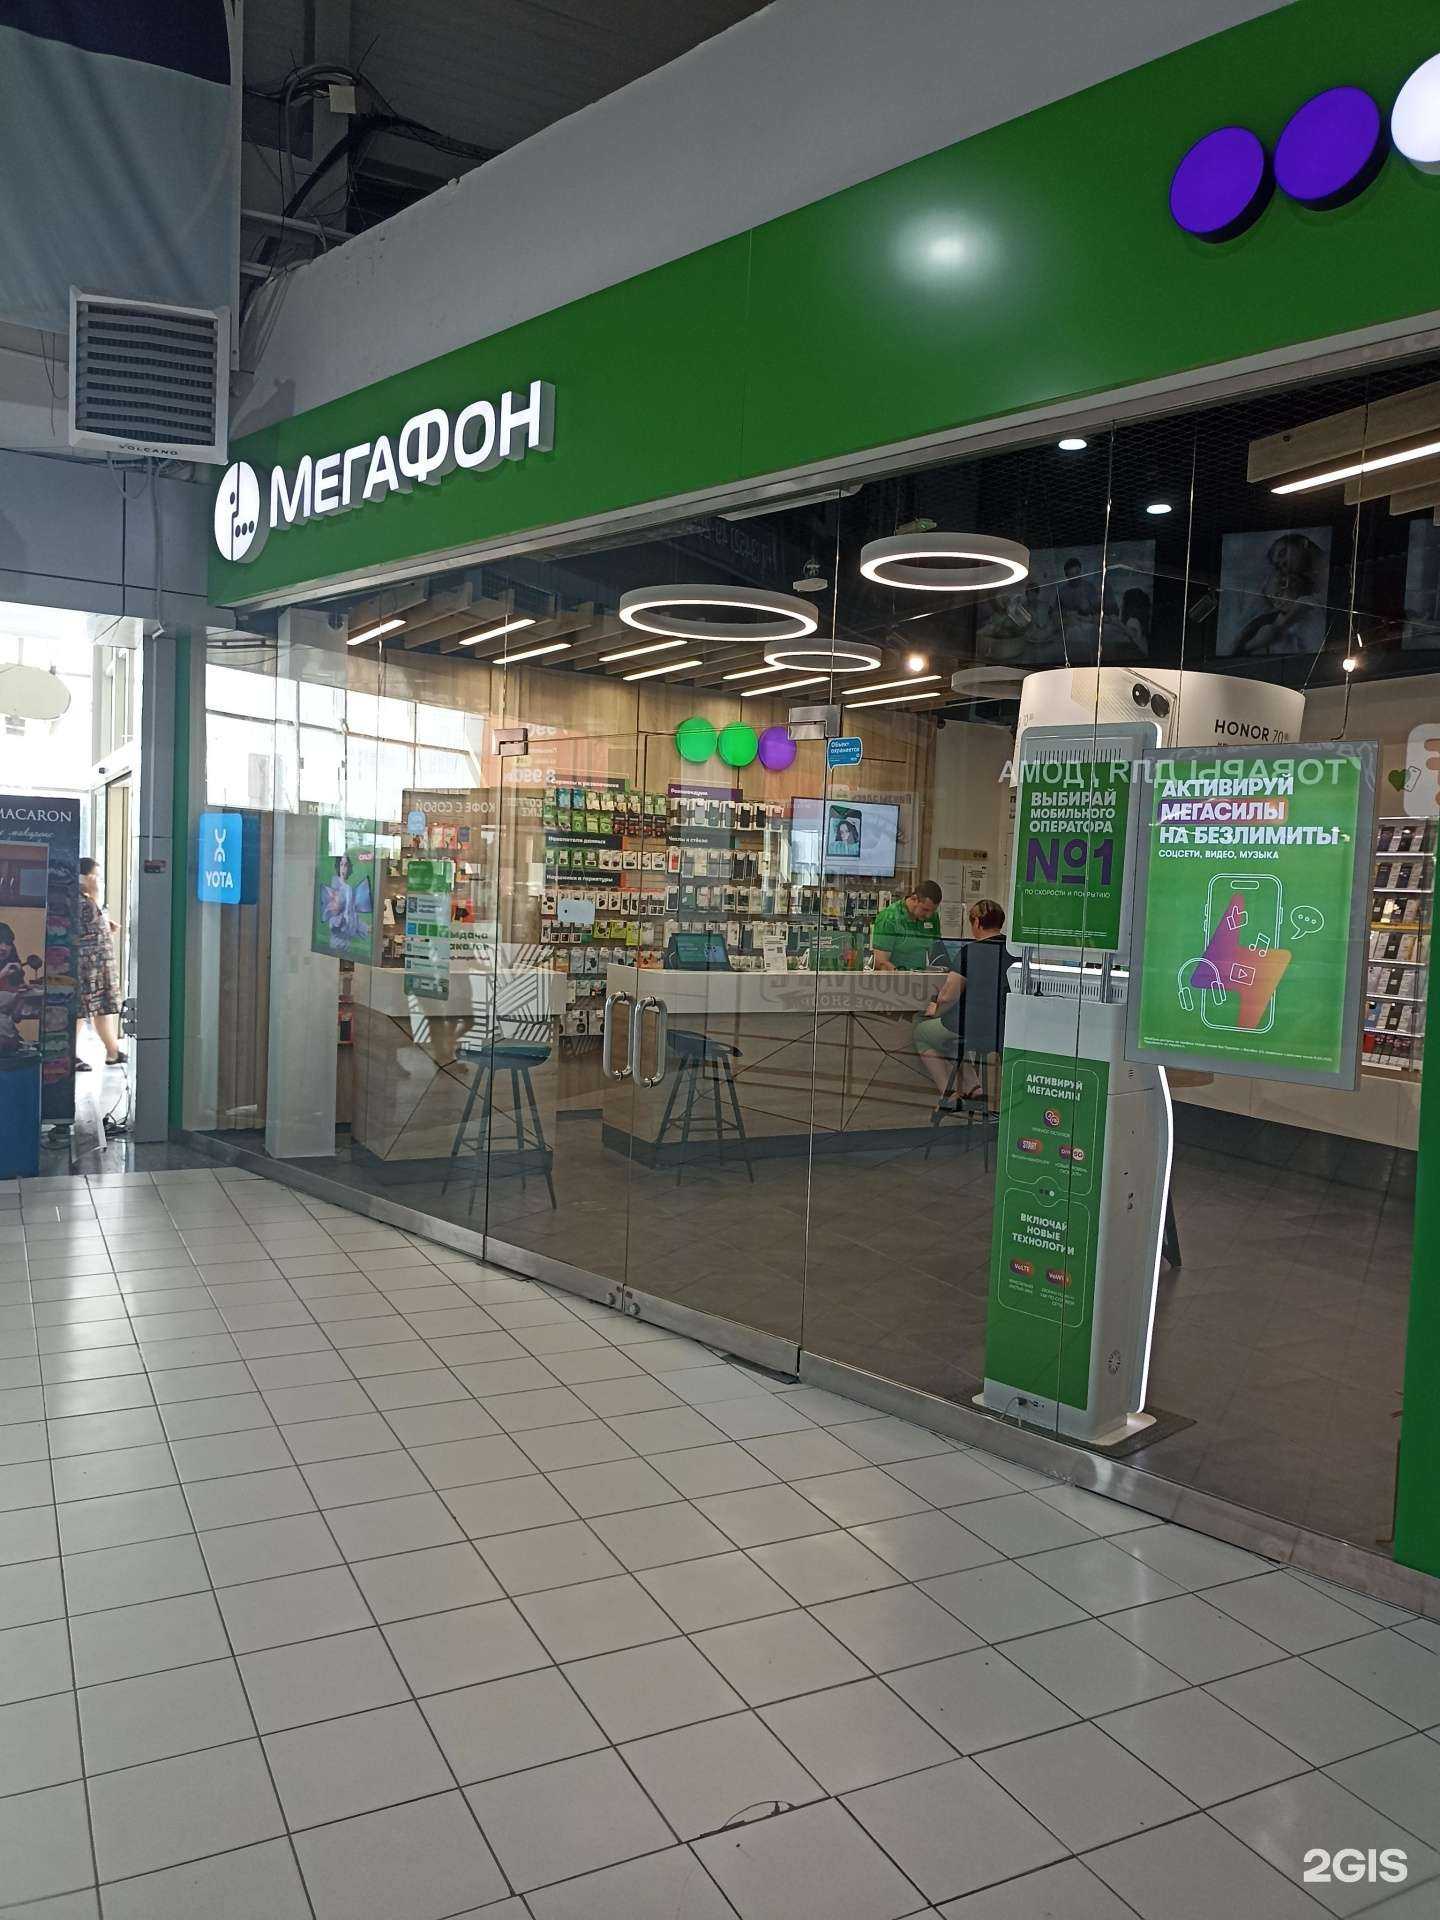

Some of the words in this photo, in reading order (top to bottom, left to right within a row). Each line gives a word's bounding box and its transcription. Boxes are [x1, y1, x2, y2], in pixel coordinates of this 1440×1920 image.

[119, 444, 178, 456] VOLCANO
[269, 379, 546, 529] МЕГАФОН
[1214, 719, 1269, 741] HONOR
[1162, 772, 1294, 798] АКТИВИРУЙ
[1031, 788, 1117, 807] ВЫБИРАЙ
[1030, 808, 1115, 819] МОБИЛЬНОГО
[1160, 802, 1285, 820] МЕГАСИЛЫ
[1029, 820, 1113, 833] ОПЕРАТОРА
[1159, 826, 1189, 844] НА
[1195, 826, 1339, 845] БЕЗЛИМИТЫ
[1158, 850, 1203, 859] СОЦСЕТИ,
[1205, 850, 1237, 860] ВИДЕО,
[1239, 850, 1279, 859] МУЗЫКА
[206, 870, 233, 888] YOTA
[1026, 1074, 1083, 1090] АКТИВИРУЙ
[1027, 1085, 1081, 1101] МЕГАСИЛЫ
[1020, 1213, 1068, 1231] ВКЛЮЧАЙ
[1027, 1225, 1061, 1241] НОВЫЕ
[1012, 1232, 1075, 1256] ТЕХНОЛОГИИ
